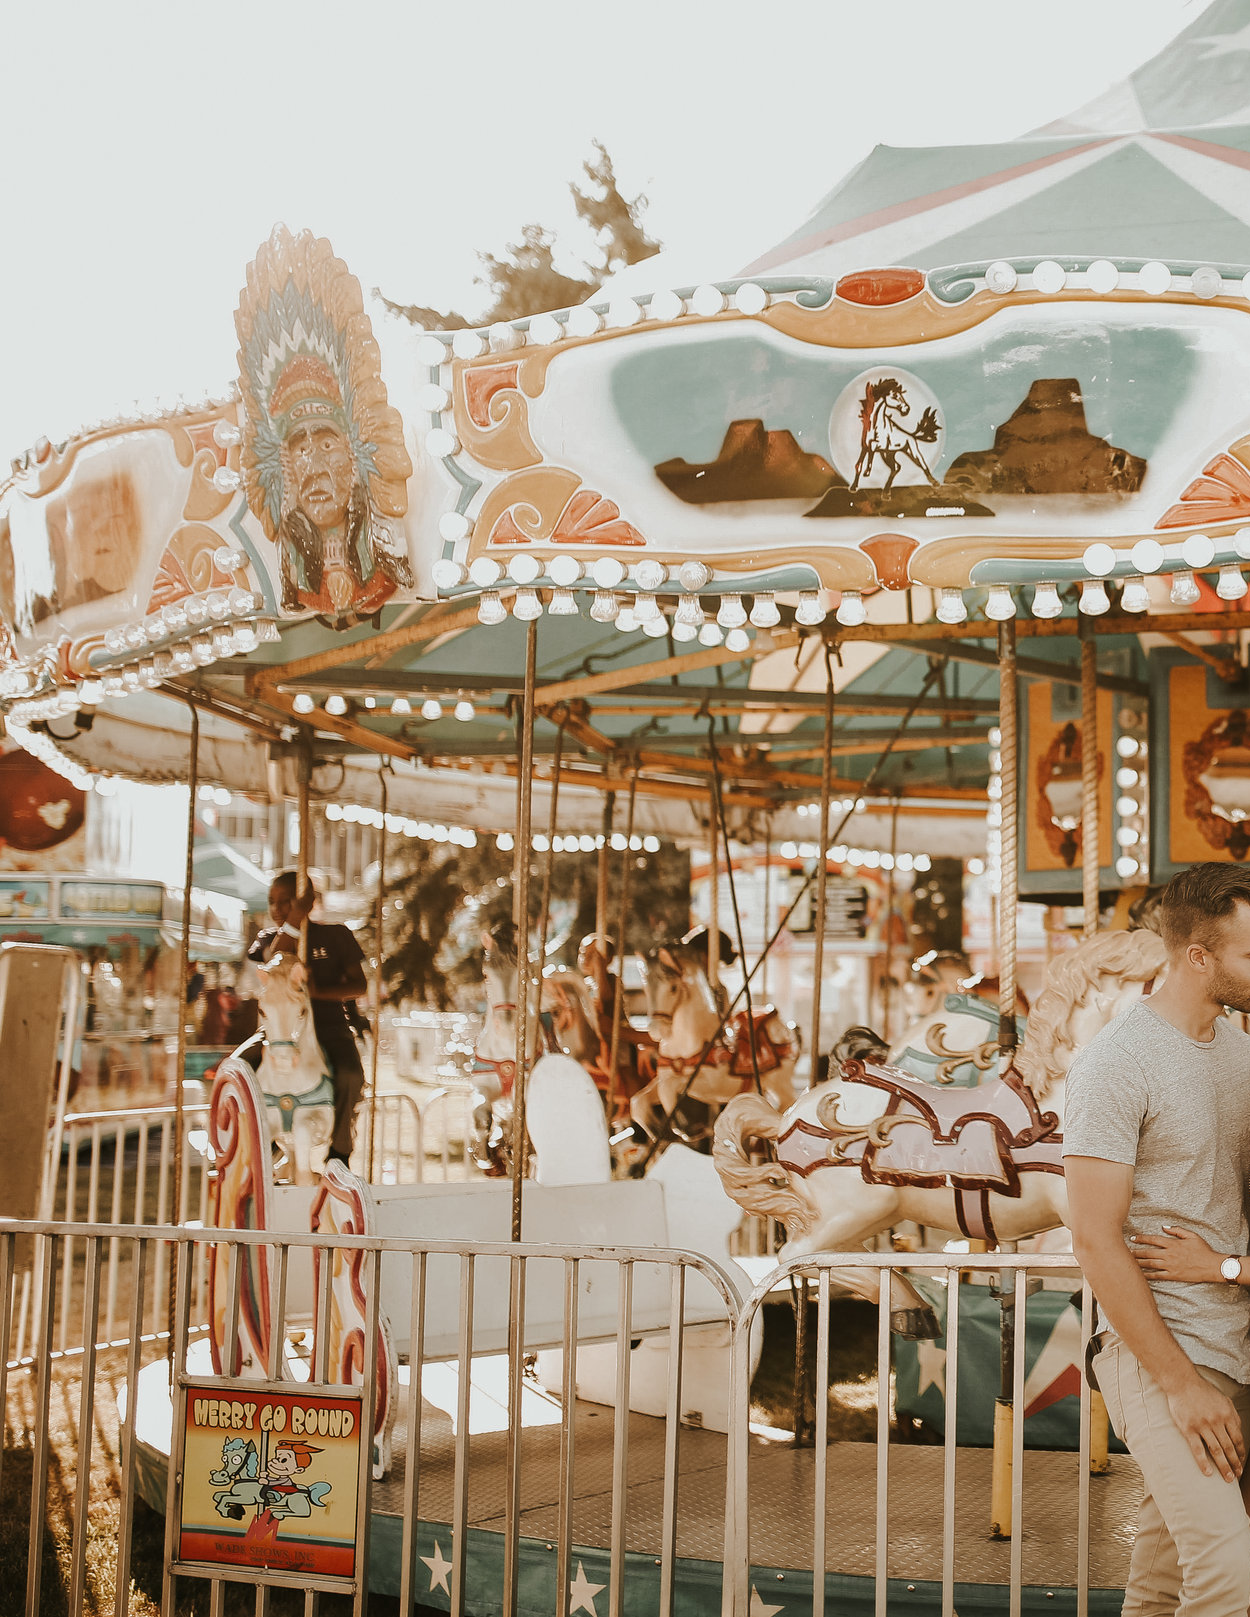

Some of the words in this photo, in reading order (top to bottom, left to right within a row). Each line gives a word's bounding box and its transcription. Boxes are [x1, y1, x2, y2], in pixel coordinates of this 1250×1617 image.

[193, 1399, 257, 1429] MERRY
[260, 1404, 287, 1432] GO
[291, 1405, 355, 1438] ROUND
[215, 1542, 246, 1555] WADE
